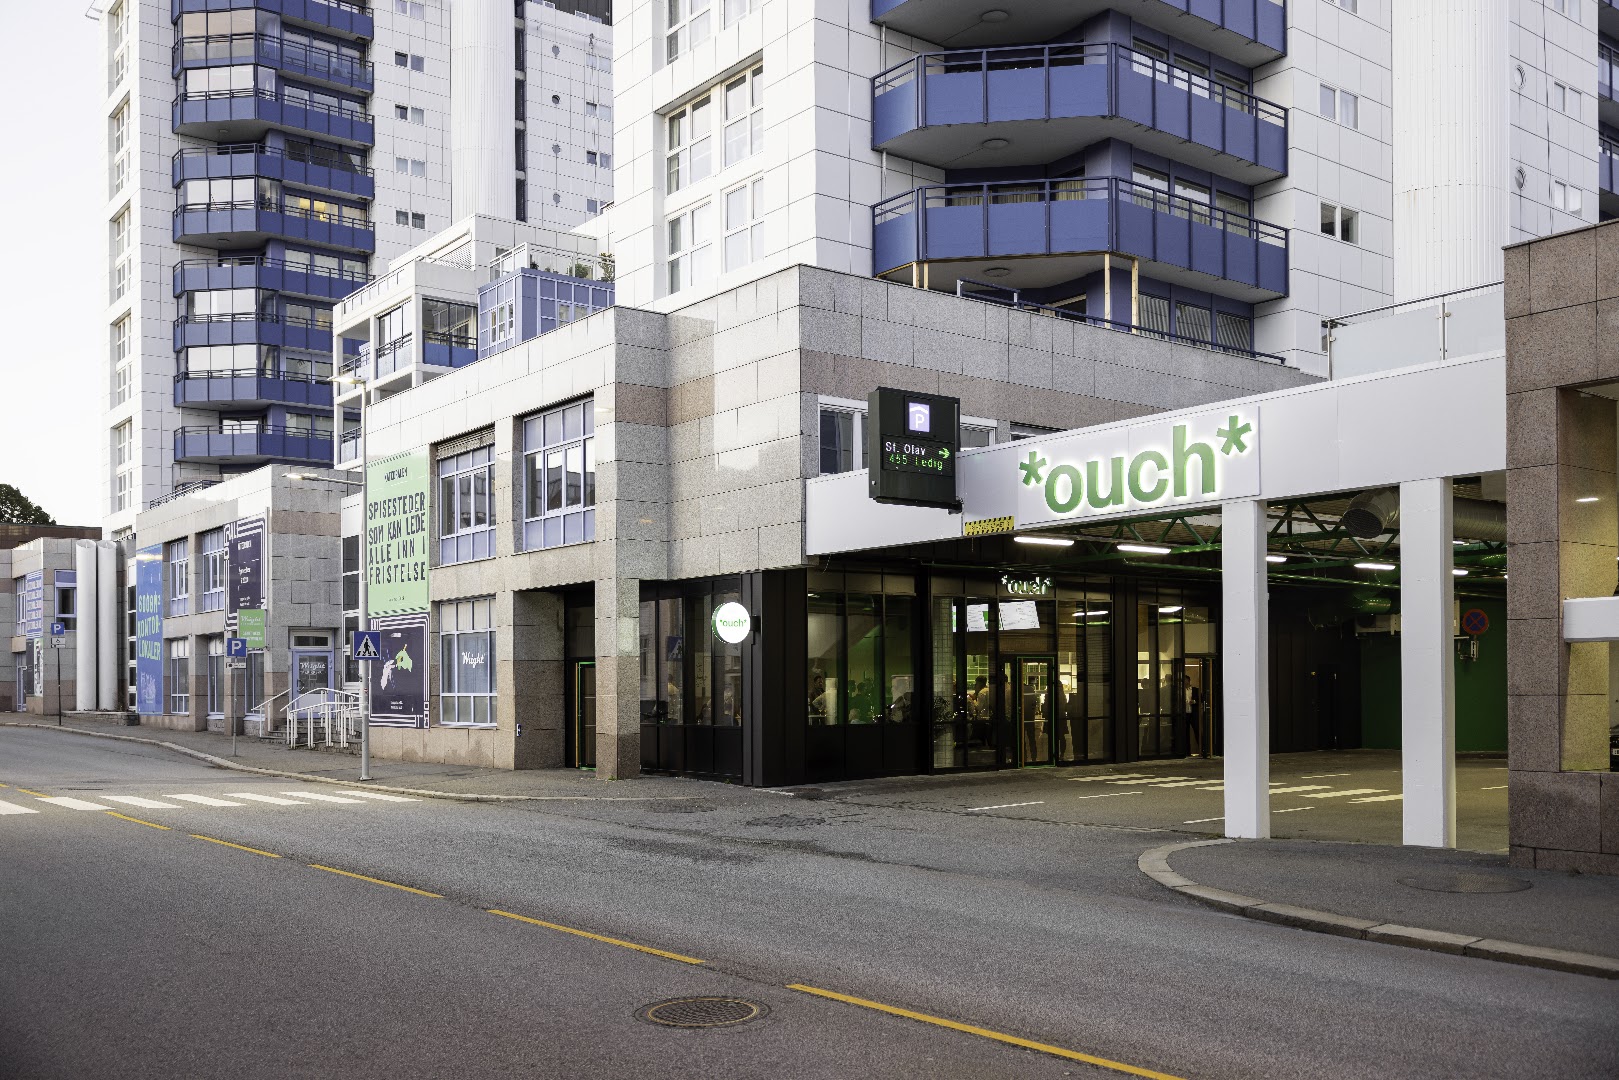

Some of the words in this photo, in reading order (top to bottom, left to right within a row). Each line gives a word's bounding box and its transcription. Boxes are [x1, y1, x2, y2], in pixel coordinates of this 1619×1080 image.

[915, 413, 925, 429] P
[903, 443, 926, 456] Olav
[368, 491, 426, 521] SPISESTEDER
[368, 524, 384, 546] SOM
[387, 518, 402, 542] KAN
[405, 511, 426, 536] LEDE
[368, 542, 392, 567] ALLE
[397, 537, 415, 560] INN
[422, 535, 426, 555] I
[369, 561, 426, 586] FRISTELSE
[53, 623, 62, 634] P
[231, 640, 242, 655] P
